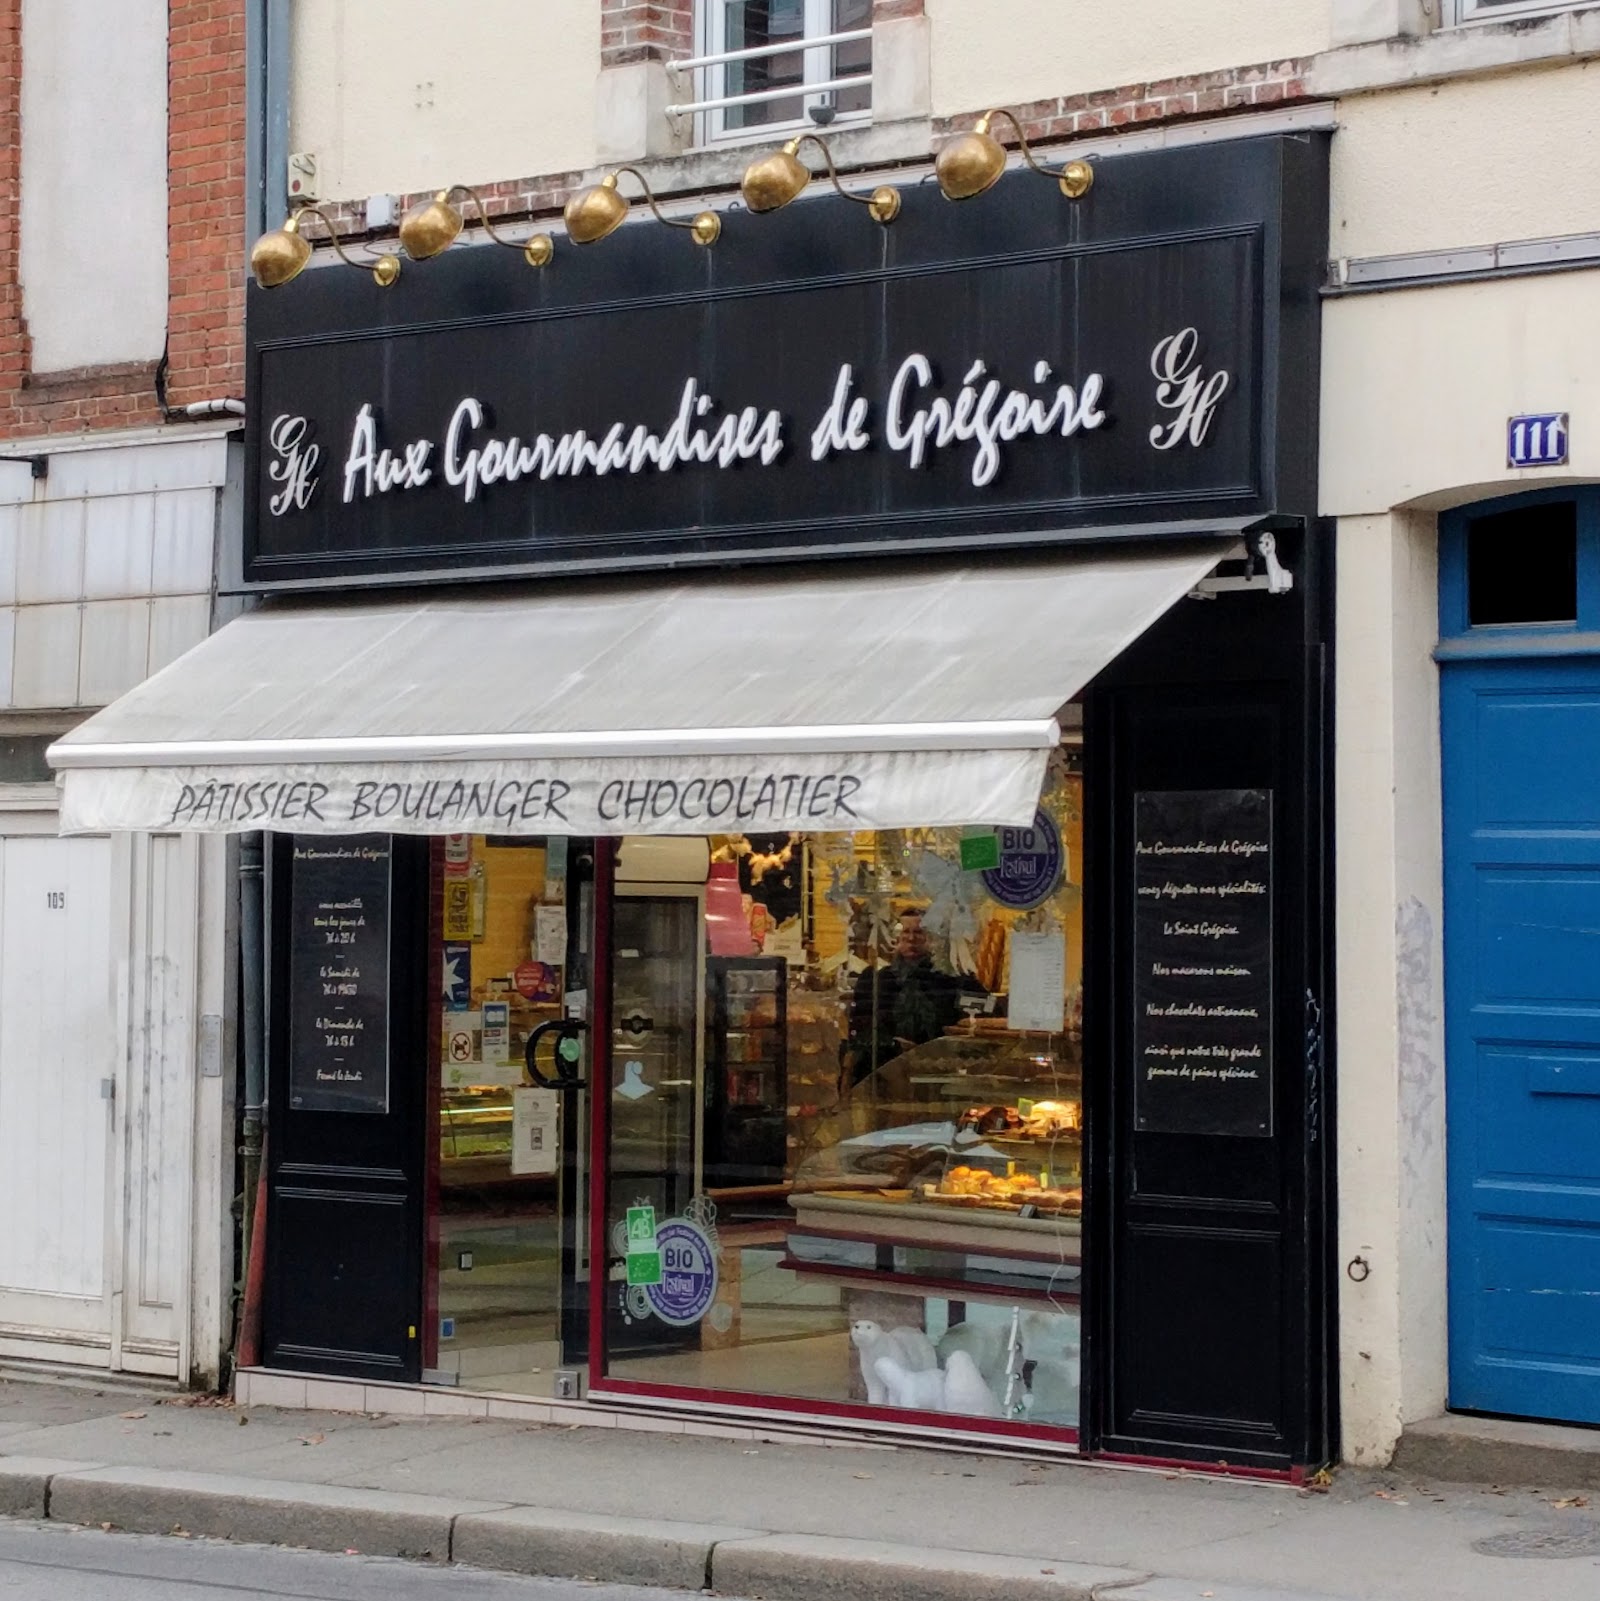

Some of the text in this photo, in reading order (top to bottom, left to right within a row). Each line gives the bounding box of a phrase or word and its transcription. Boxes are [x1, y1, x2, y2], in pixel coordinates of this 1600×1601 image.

[343, 353, 1106, 503] Aux Gourmandises de Grégoire
[1513, 420, 1562, 461] 111
[171, 774, 861, 827] PÂTISSIER BOULANGER CHOCOLATIER
[1002, 829, 1036, 850] BIO
[1218, 840, 1229, 853] de
[1152, 962, 1170, 975] Nos
[1171, 967, 1214, 975] macarons
[1146, 1003, 1164, 1016] Nos
[1165, 1003, 1206, 1016] chocolats
[1145, 1045, 1169, 1055] ainsi
[1170, 1047, 1185, 1060] que
[1186, 1046, 1211, 1056] notre
[1230, 1044, 1262, 1062] grande
[1180, 1064, 1191, 1077] de
[1191, 1066, 1217, 1081] pains
[631, 1218, 651, 1238] AB
[664, 1248, 693, 1268] BIO
